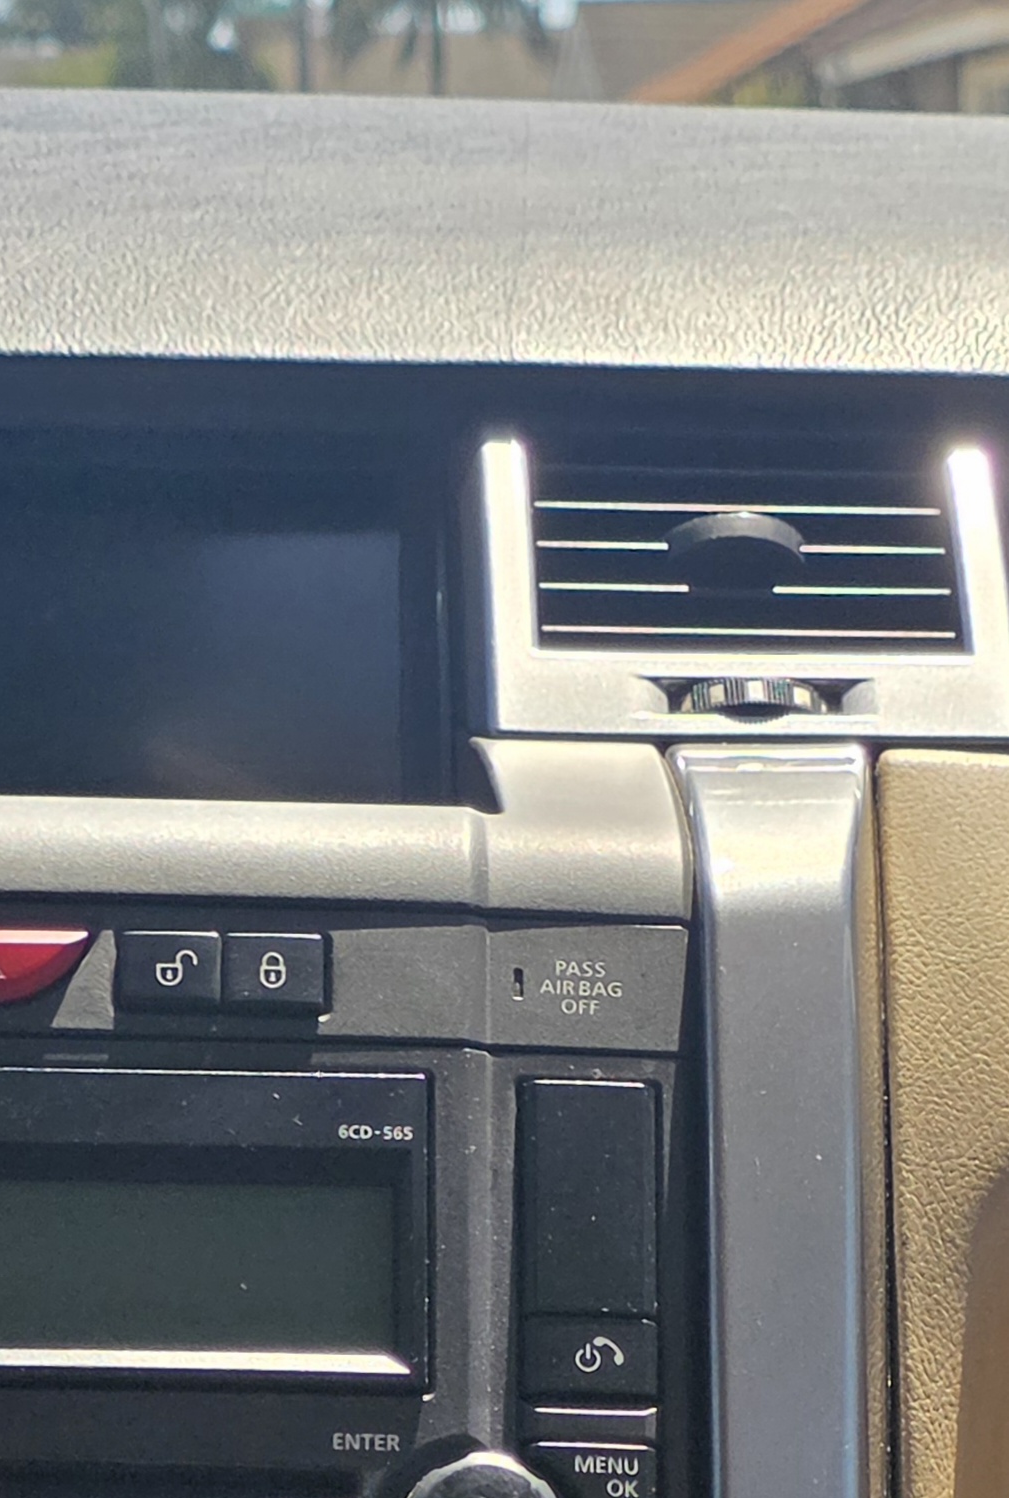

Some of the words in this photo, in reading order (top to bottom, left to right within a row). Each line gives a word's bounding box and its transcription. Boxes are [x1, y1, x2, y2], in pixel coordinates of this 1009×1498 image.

[555, 960, 606, 977] PASS
[539, 978, 623, 998] AIRBAG
[561, 998, 600, 1015] OFF
[332, 1434, 400, 1452] ENTER
[575, 1458, 640, 1477] MENU
[607, 1482, 640, 1498] OK
